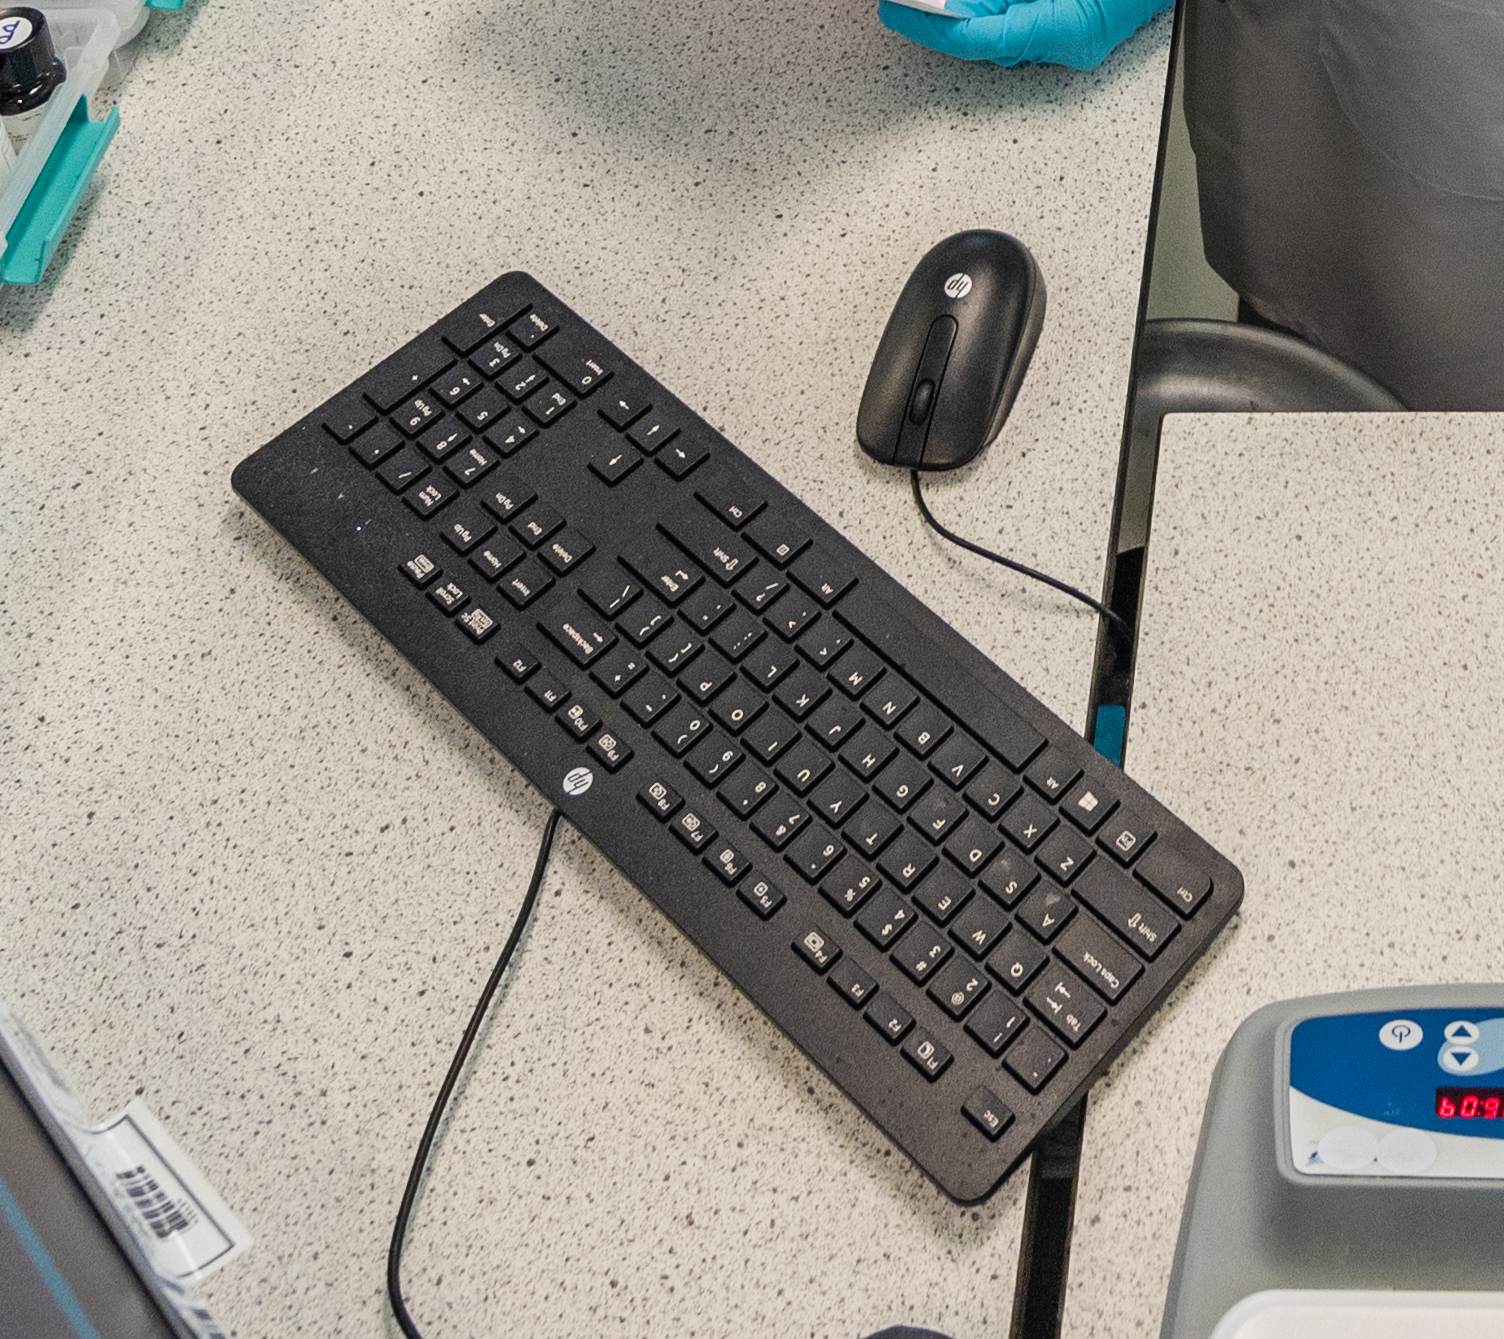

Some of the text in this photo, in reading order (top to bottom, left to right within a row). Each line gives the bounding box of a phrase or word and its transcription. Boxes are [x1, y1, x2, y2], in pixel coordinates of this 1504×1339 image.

[484, 551, 501, 568] Home
[553, 544, 572, 562] Delete
[512, 579, 530, 596] Insert
[661, 576, 679, 591] Enter
[563, 624, 593, 654] Backspace
[513, 660, 526, 672] F12
[768, 666, 777, 677] L
[849, 672, 862, 685] M
[700, 682, 712, 691] P
[796, 694, 809, 707] K
[883, 702, 896, 714] N
[732, 710, 743, 720] O
[829, 726, 841, 734] J
[918, 732, 930, 744] B
[722, 751, 733, 761] 9
[862, 754, 875, 767] H
[797, 769, 810, 782] U
[952, 765, 963, 777] V
[563, 767, 593, 795] hp
[897, 785, 908, 797] G
[988, 793, 1000, 805] C
[830, 801, 842, 813] Y
[789, 815, 800, 824] 7
[933, 820, 945, 829] F
[1024, 824, 1037, 838] X
[866, 833, 877, 845] T
[970, 849, 982, 862] D
[903, 864, 915, 877] R
[1061, 857, 1074, 871] Z
[859, 877, 870, 888] 5
[1006, 881, 1017, 893] S
[1177, 887, 1192, 902] Ctrl
[938, 896, 951, 910] E
[1043, 914, 1054, 927] A
[972, 930, 986, 945] W
[1139, 923, 1157, 942] Shift
[929, 946, 940, 957] 3
[1011, 962, 1023, 977] Q
[1084, 952, 1119, 988] Caps Lock
[852, 984, 864, 997] F3
[967, 978, 978, 991] 2
[889, 1019, 901, 1032] F2
[1067, 1014, 1081, 1032] Tab
[984, 1110, 998, 1127] Esc
